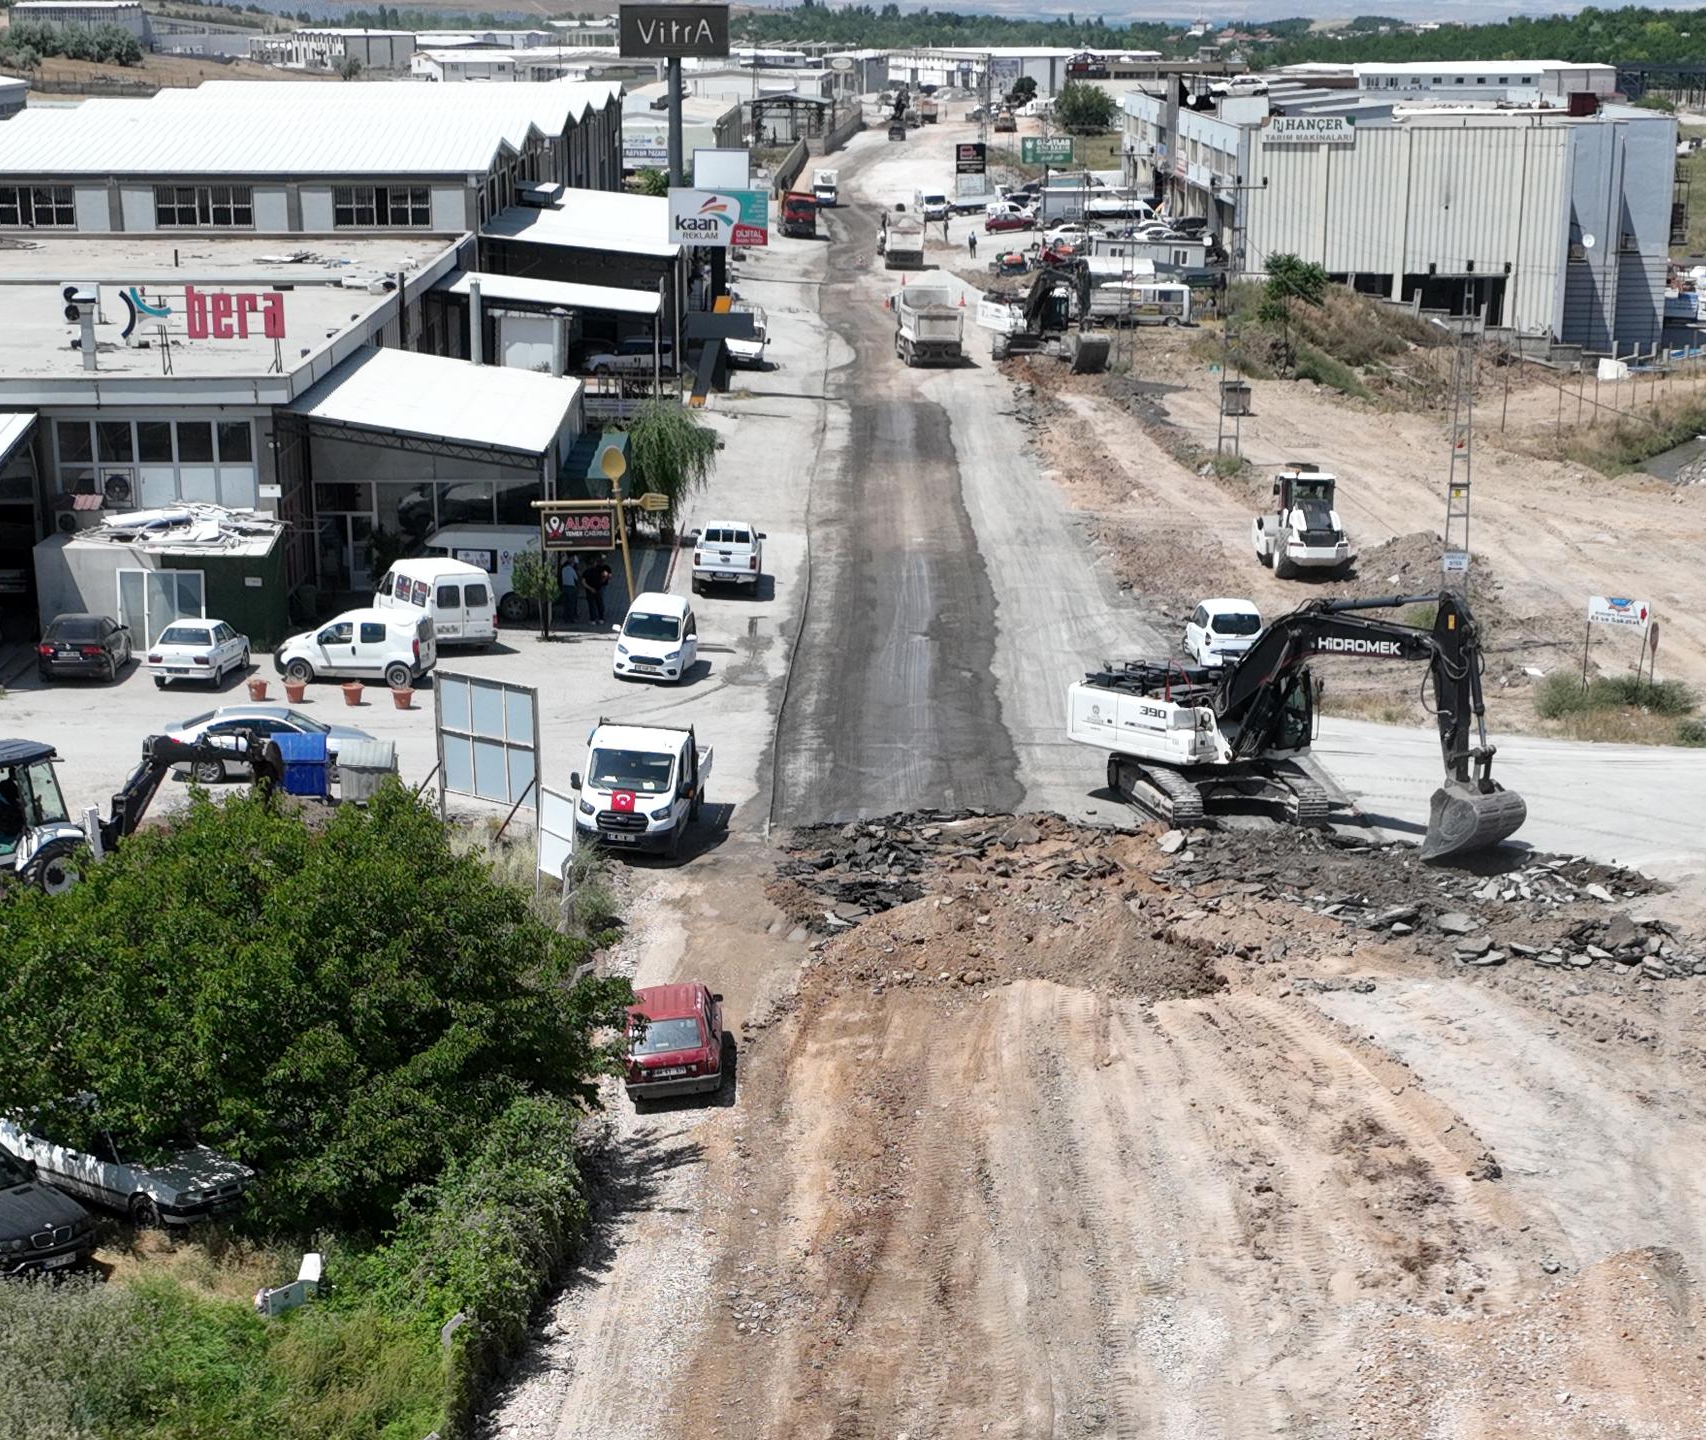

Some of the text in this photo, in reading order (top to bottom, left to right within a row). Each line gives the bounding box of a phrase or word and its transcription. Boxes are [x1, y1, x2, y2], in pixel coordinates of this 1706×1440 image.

[637, 18, 714, 44] VitrA
[1285, 119, 1343, 132] HANÇER
[675, 214, 718, 230] kaan
[683, 232, 718, 240] REKLAM
[185, 284, 286, 339] bera
[565, 516, 610, 530] ALSOS
[1139, 706, 1167, 719] 390
